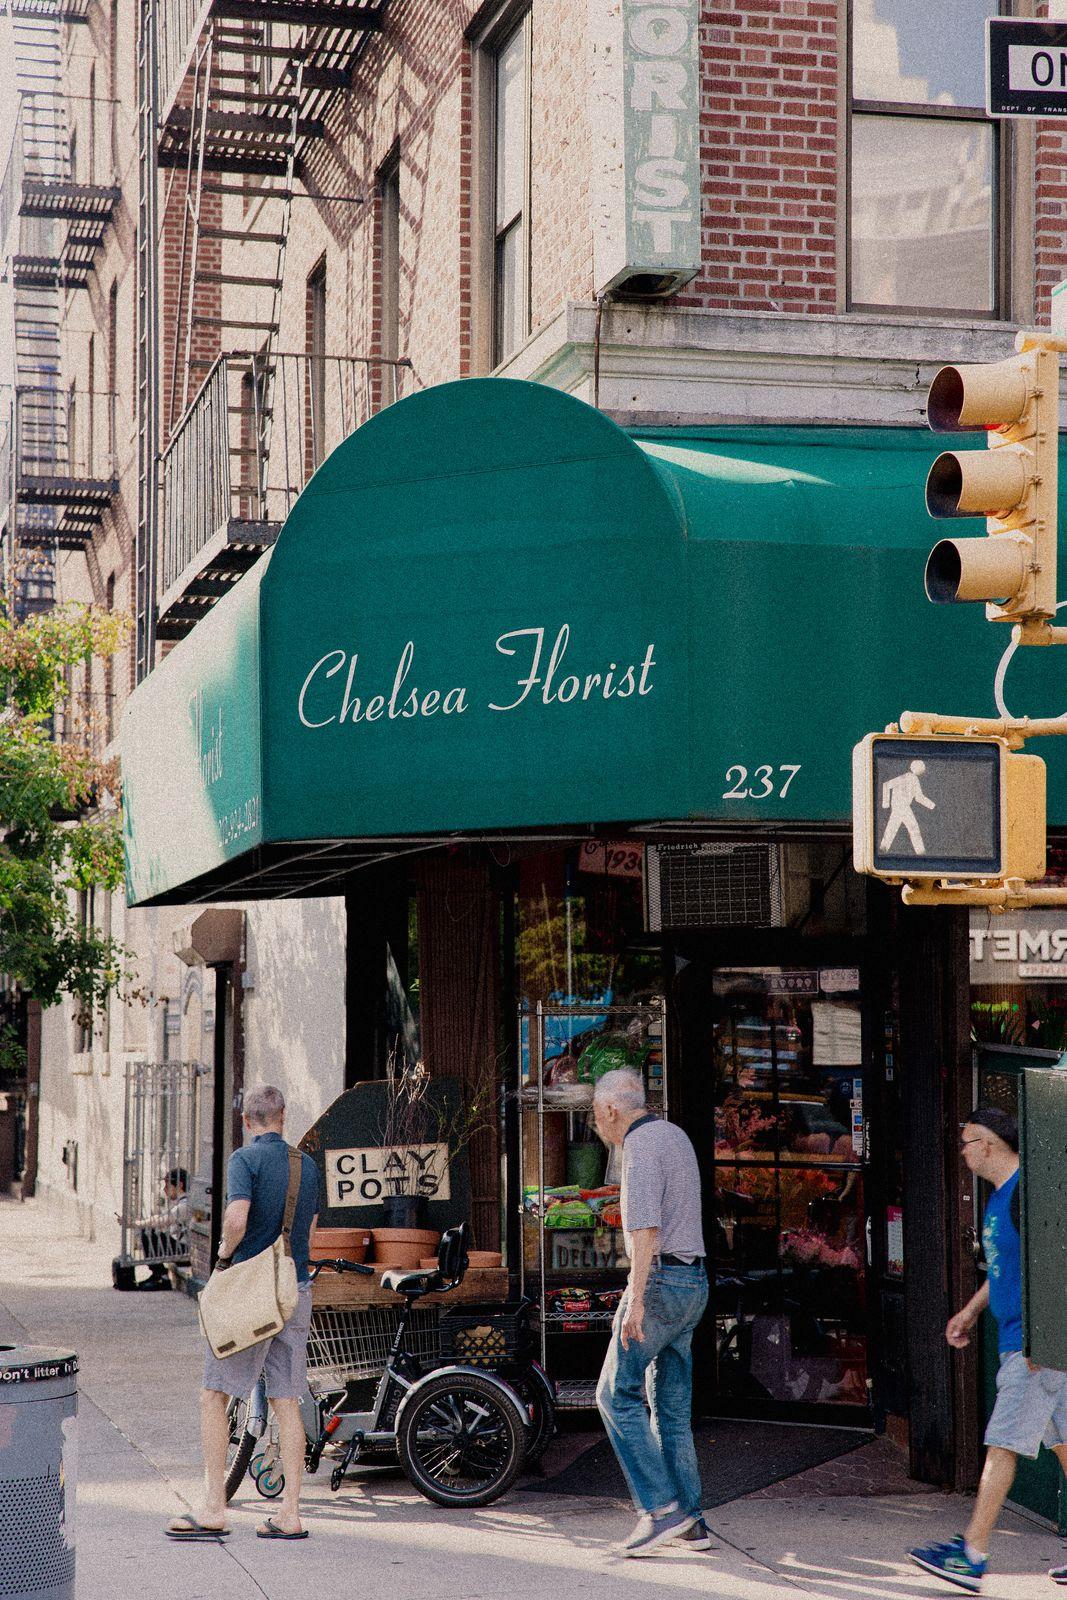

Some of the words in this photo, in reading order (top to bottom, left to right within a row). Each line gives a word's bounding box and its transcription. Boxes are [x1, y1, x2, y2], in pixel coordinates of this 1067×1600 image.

[629, 0, 692, 254] ORIST
[298, 641, 469, 728] Chelsea
[488, 623, 657, 711] Florist
[722, 764, 802, 799] 237
[657, 843, 699, 852] Friedrich
[336, 1149, 437, 1175] CLAY
[337, 1174, 439, 1201] POTS
[0, 1368, 30, 1380] on't
[34, 1366, 60, 1378] litter
